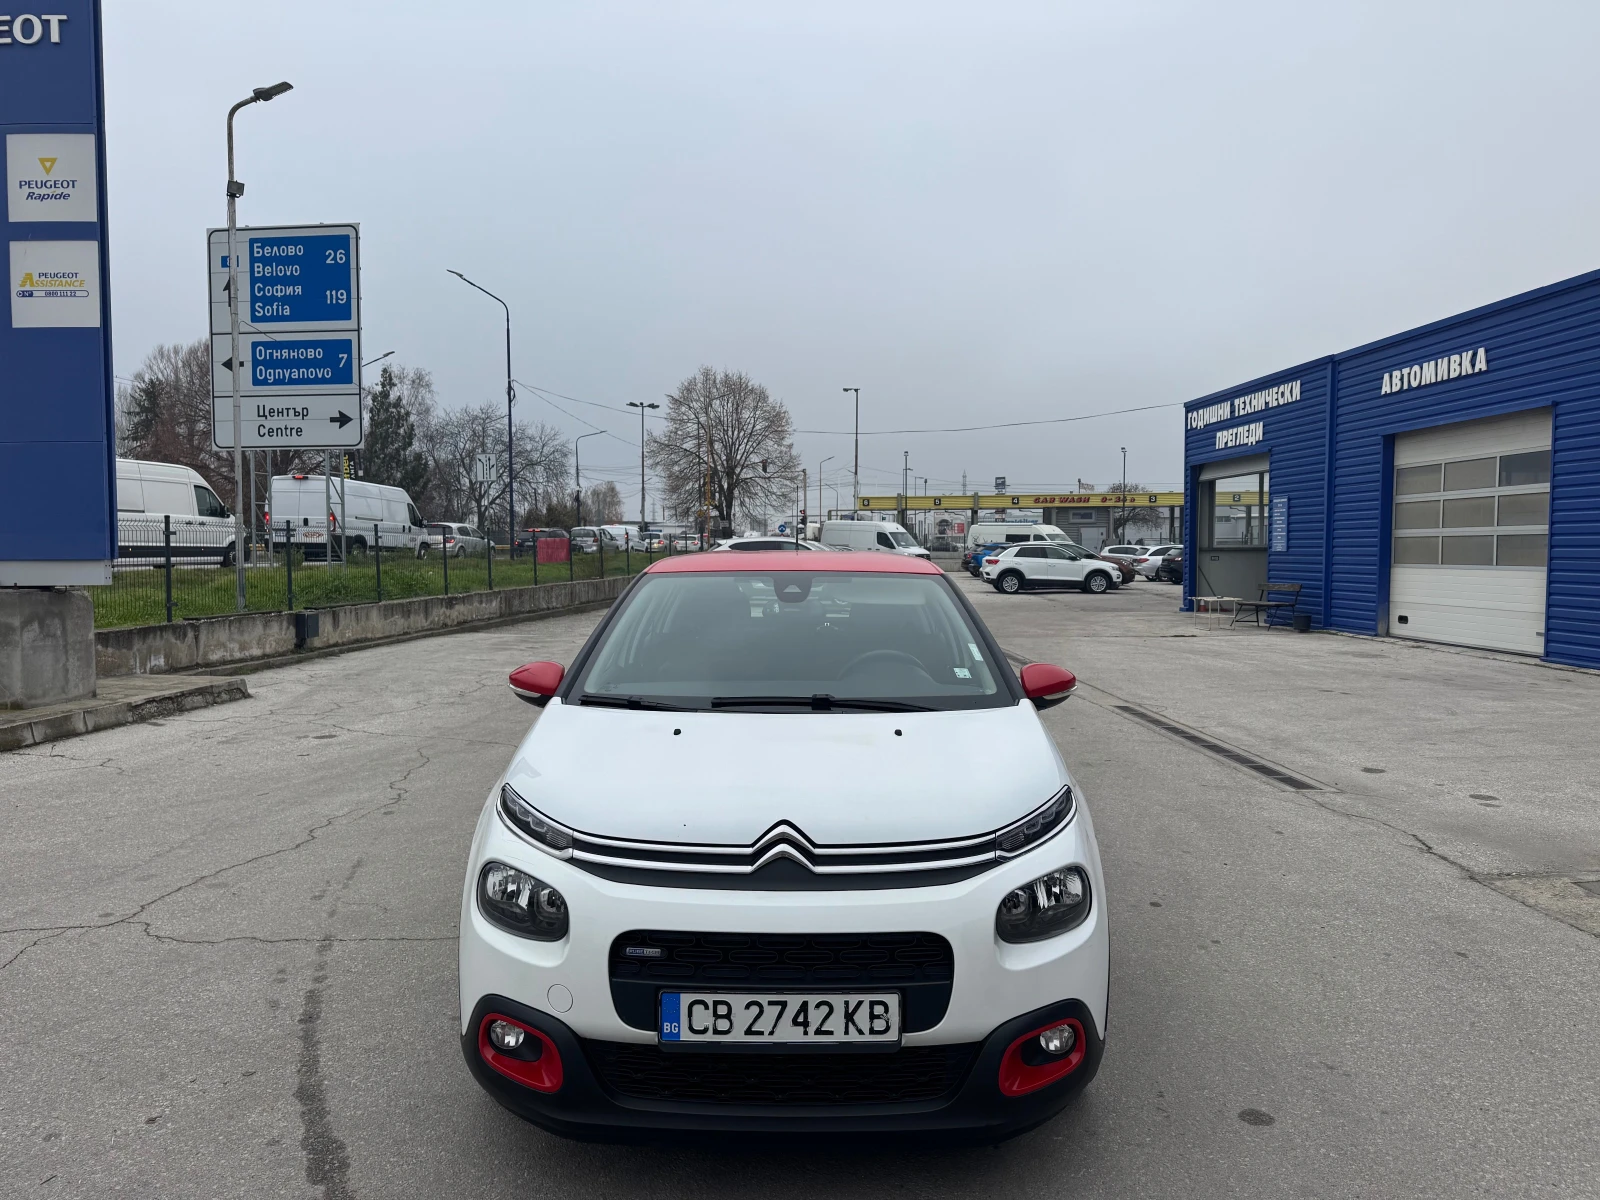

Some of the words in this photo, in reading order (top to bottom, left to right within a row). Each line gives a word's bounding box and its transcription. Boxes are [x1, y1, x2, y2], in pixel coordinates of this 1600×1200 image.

[19, 180, 77, 189] PEUGEOT
[26, 190, 71, 202] Rapide
[253, 243, 304, 257] Белово
[325, 250, 346, 264] 26
[254, 263, 300, 277] Belovo
[255, 283, 302, 298] София
[325, 290, 347, 304] 119
[255, 302, 290, 317] Sofia
[256, 347, 323, 361] Огняново
[338, 354, 348, 368] 7
[256, 366, 332, 382] Ognyanovo
[1381, 347, 1488, 395] АВТОМИВКА
[1187, 401, 1231, 429] ГОДИШНИ
[1234, 380, 1301, 417] ТЕХНИЧЕСКИ
[257, 405, 309, 420] Център
[257, 424, 303, 437] Centre
[1215, 421, 1263, 450] ПРЕГЛЕДИ
[687, 999, 734, 1035] CB
[744, 1000, 835, 1036] 2742
[844, 1000, 892, 1036] KB
[664, 1022, 679, 1033] BG
